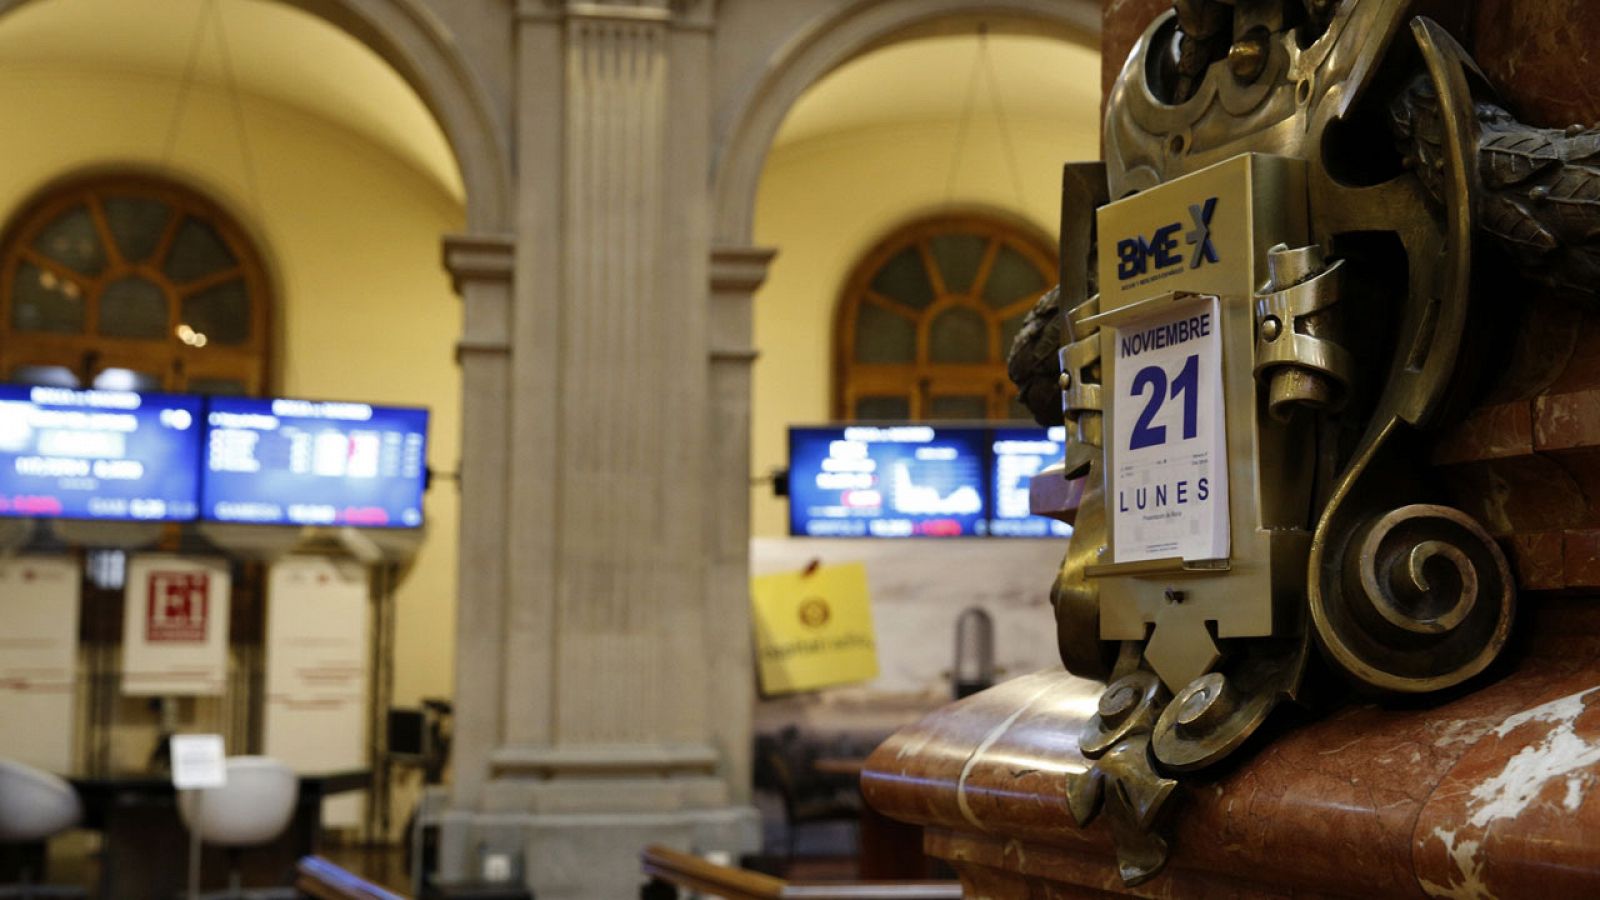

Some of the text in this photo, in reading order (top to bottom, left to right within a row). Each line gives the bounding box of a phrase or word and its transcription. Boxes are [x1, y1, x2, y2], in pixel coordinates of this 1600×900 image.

[1121, 314, 1210, 359] NOVIEMBRE
[1129, 354, 1199, 450] 21
[1120, 477, 1209, 513] LUNES
